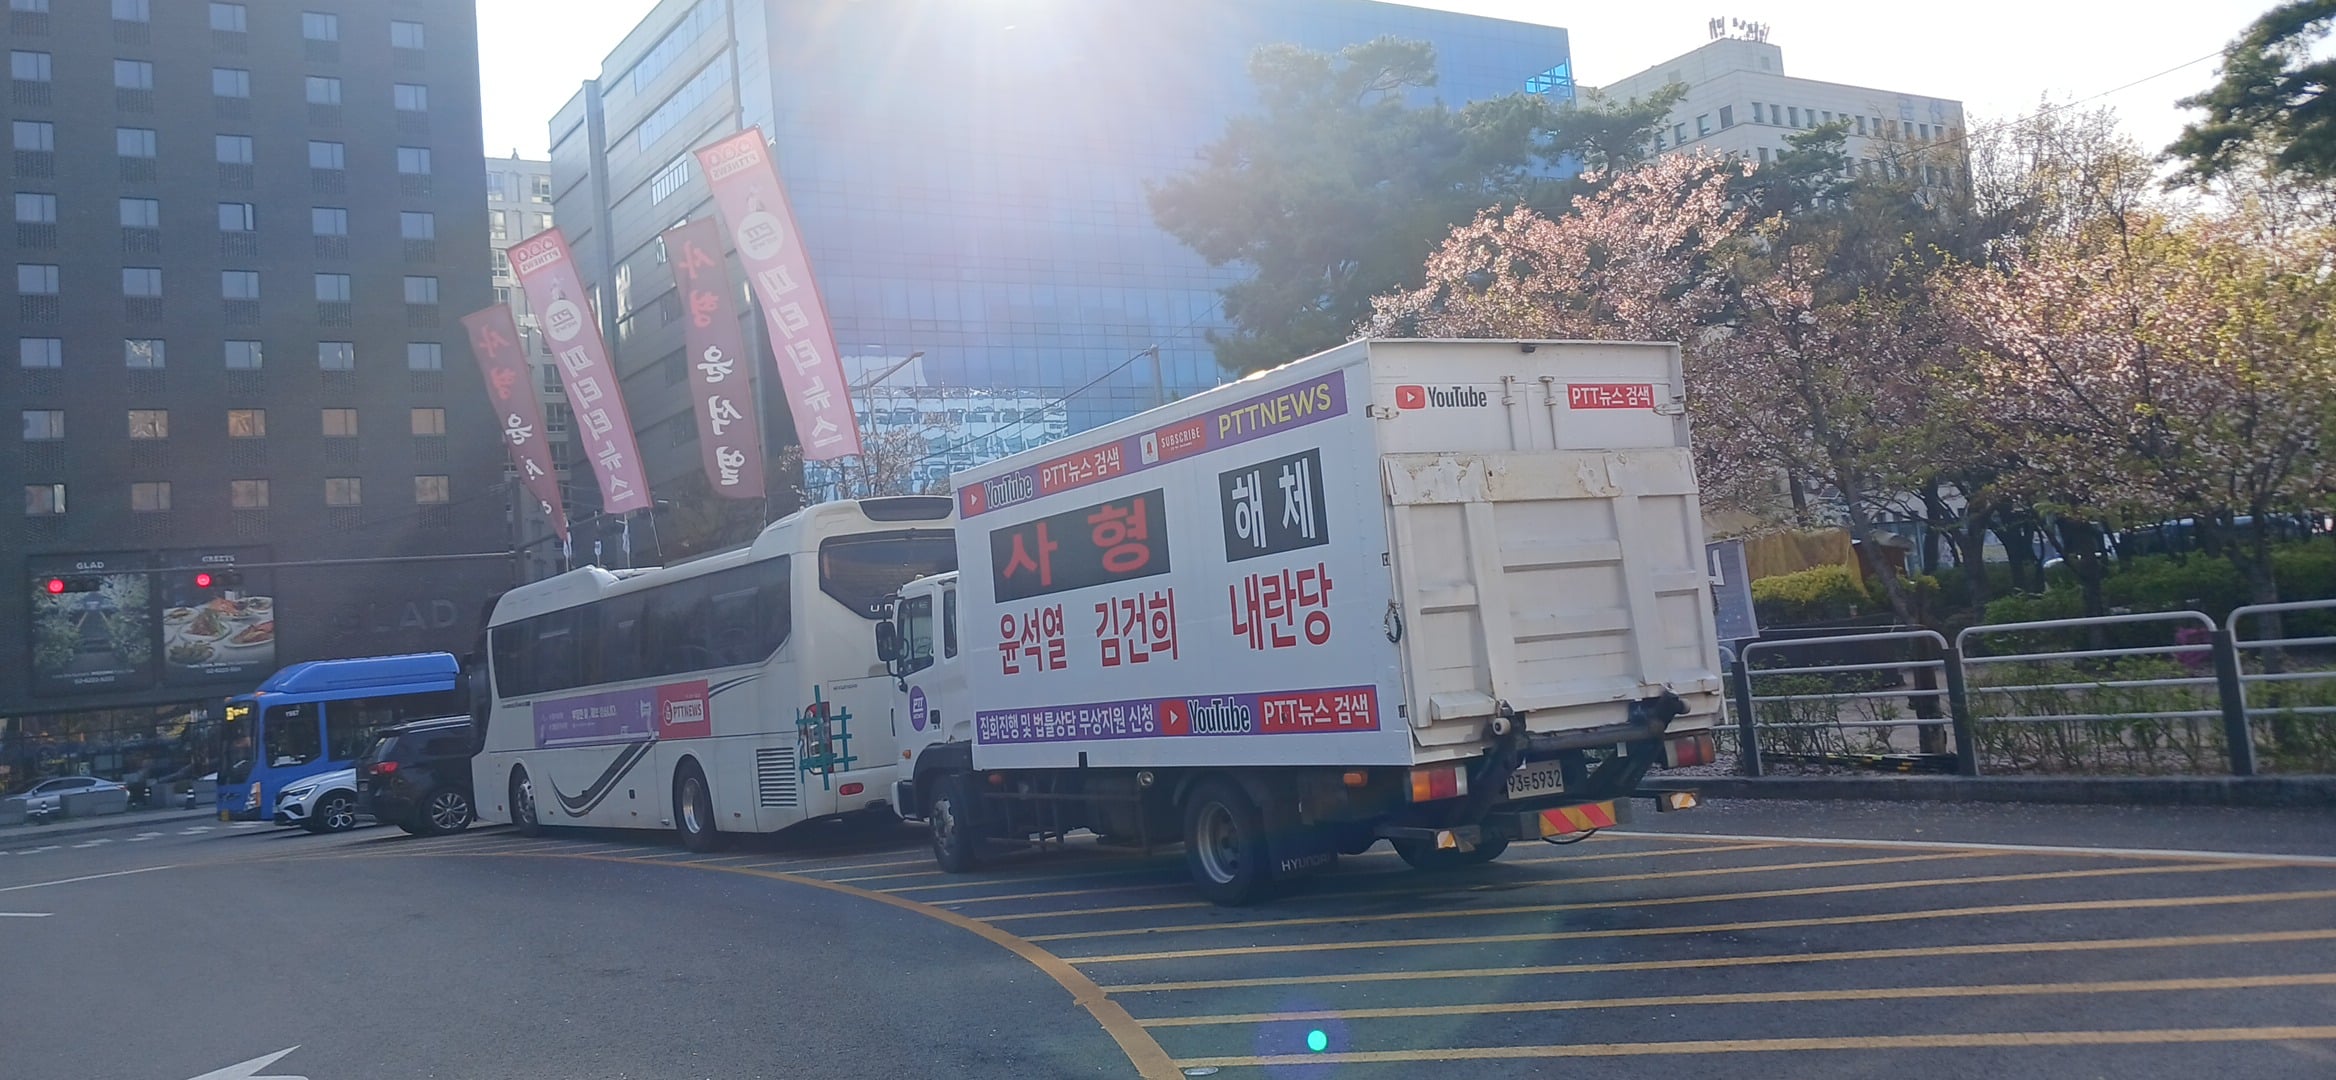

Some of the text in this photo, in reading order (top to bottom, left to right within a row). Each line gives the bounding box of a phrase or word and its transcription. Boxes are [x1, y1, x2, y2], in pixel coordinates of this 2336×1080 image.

[1218, 383, 1331, 440] PTTNEWS
[1428, 386, 1488, 409] YouTube
[1572, 385, 1651, 408] PTT뉴스 검색
[1161, 426, 1201, 449] SUBSCRIBE
[1042, 447, 1122, 489] PTT뉴스 검색
[985, 472, 1033, 508] YouTube
[75, 560, 105, 570] GLAD
[1229, 562, 1334, 652] 내란당
[998, 587, 1179, 676] 윤석열 김건희
[673, 708, 702, 724] PTTNEWS
[980, 703, 1155, 741] 집회진행 및 법률상담 무상지원 신청
[1187, 697, 1251, 735] YouTube
[1263, 693, 1370, 726] PTT뉴스 검색
[1507, 768, 1562, 793] 93두5932
[1281, 852, 1331, 872] HYUNDAI
